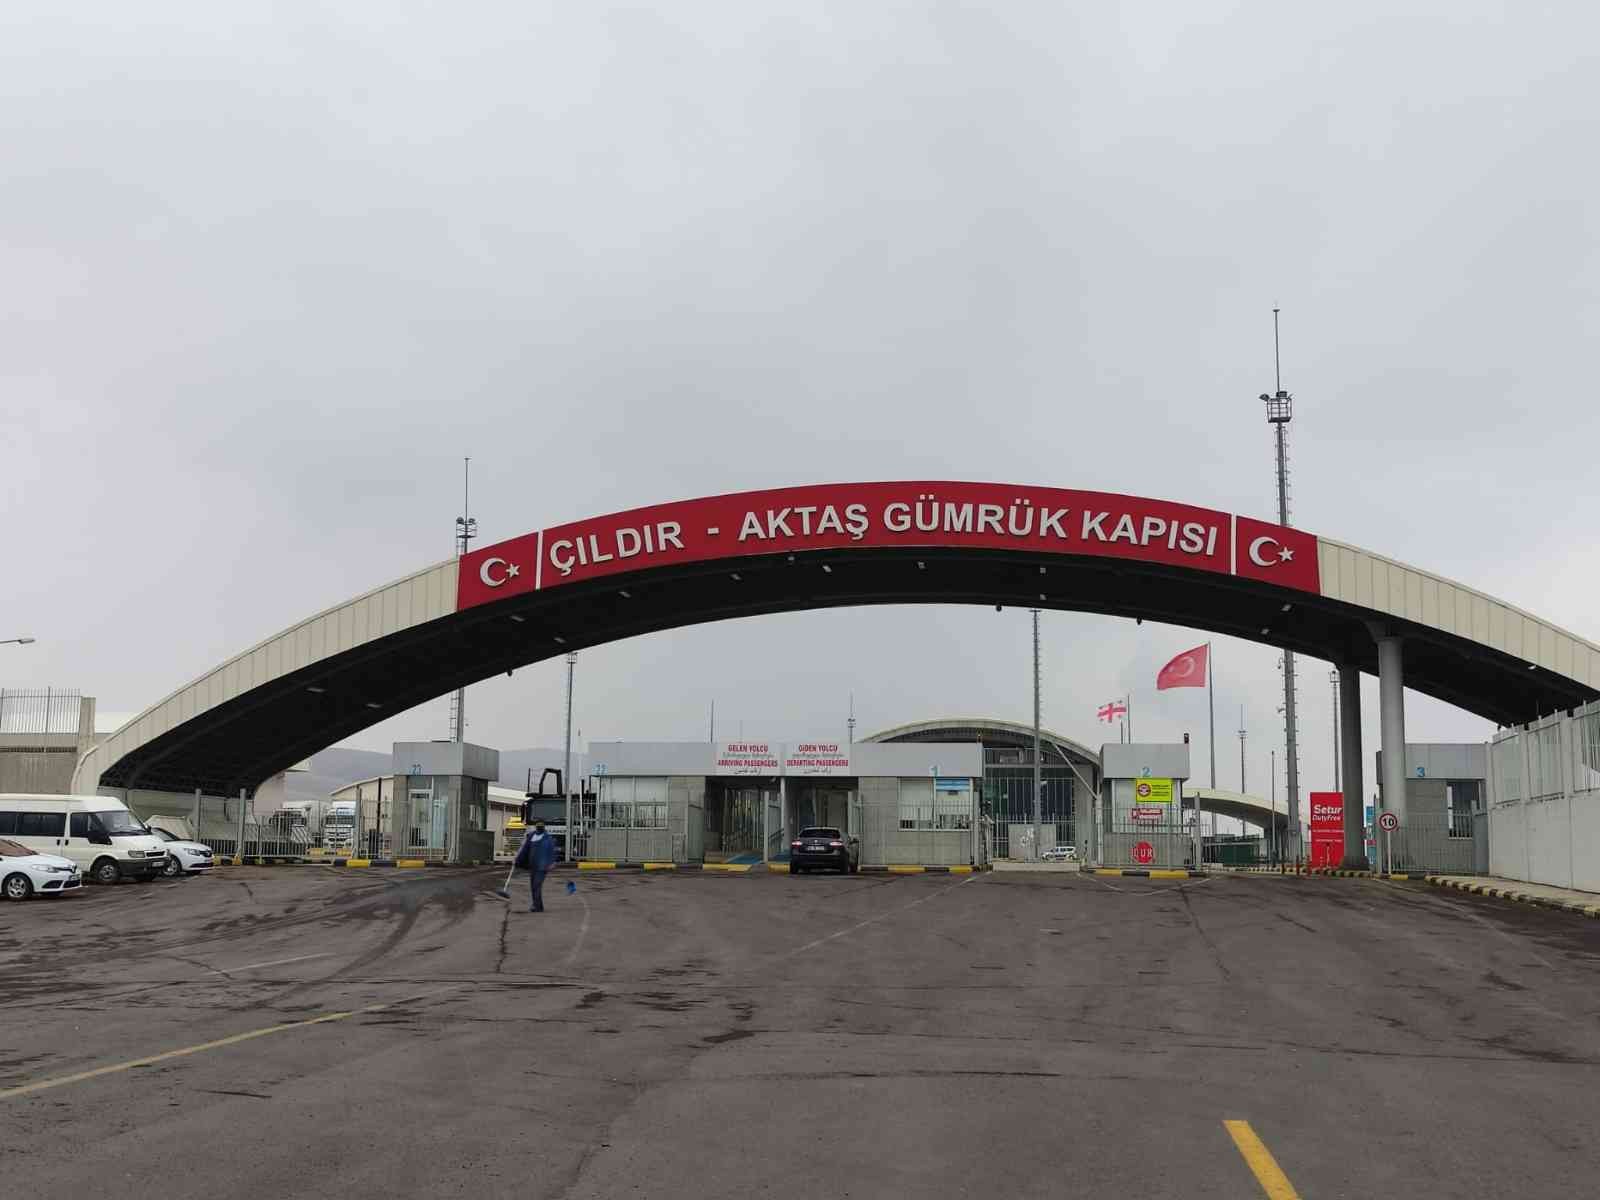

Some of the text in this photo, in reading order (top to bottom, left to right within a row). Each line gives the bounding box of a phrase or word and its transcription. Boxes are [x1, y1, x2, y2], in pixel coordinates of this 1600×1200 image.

[549, 520, 686, 575] ÇILDIR
[738, 503, 869, 540] AKTAŞ
[883, 494, 1069, 538] GÜMRÜK
[1081, 510, 1218, 556] KAPISI
[1142, 767, 1151, 778] 2
[1416, 766, 1425, 777] 3
[1313, 804, 1343, 814] Setur
[1382, 818, 1395, 827] 10
